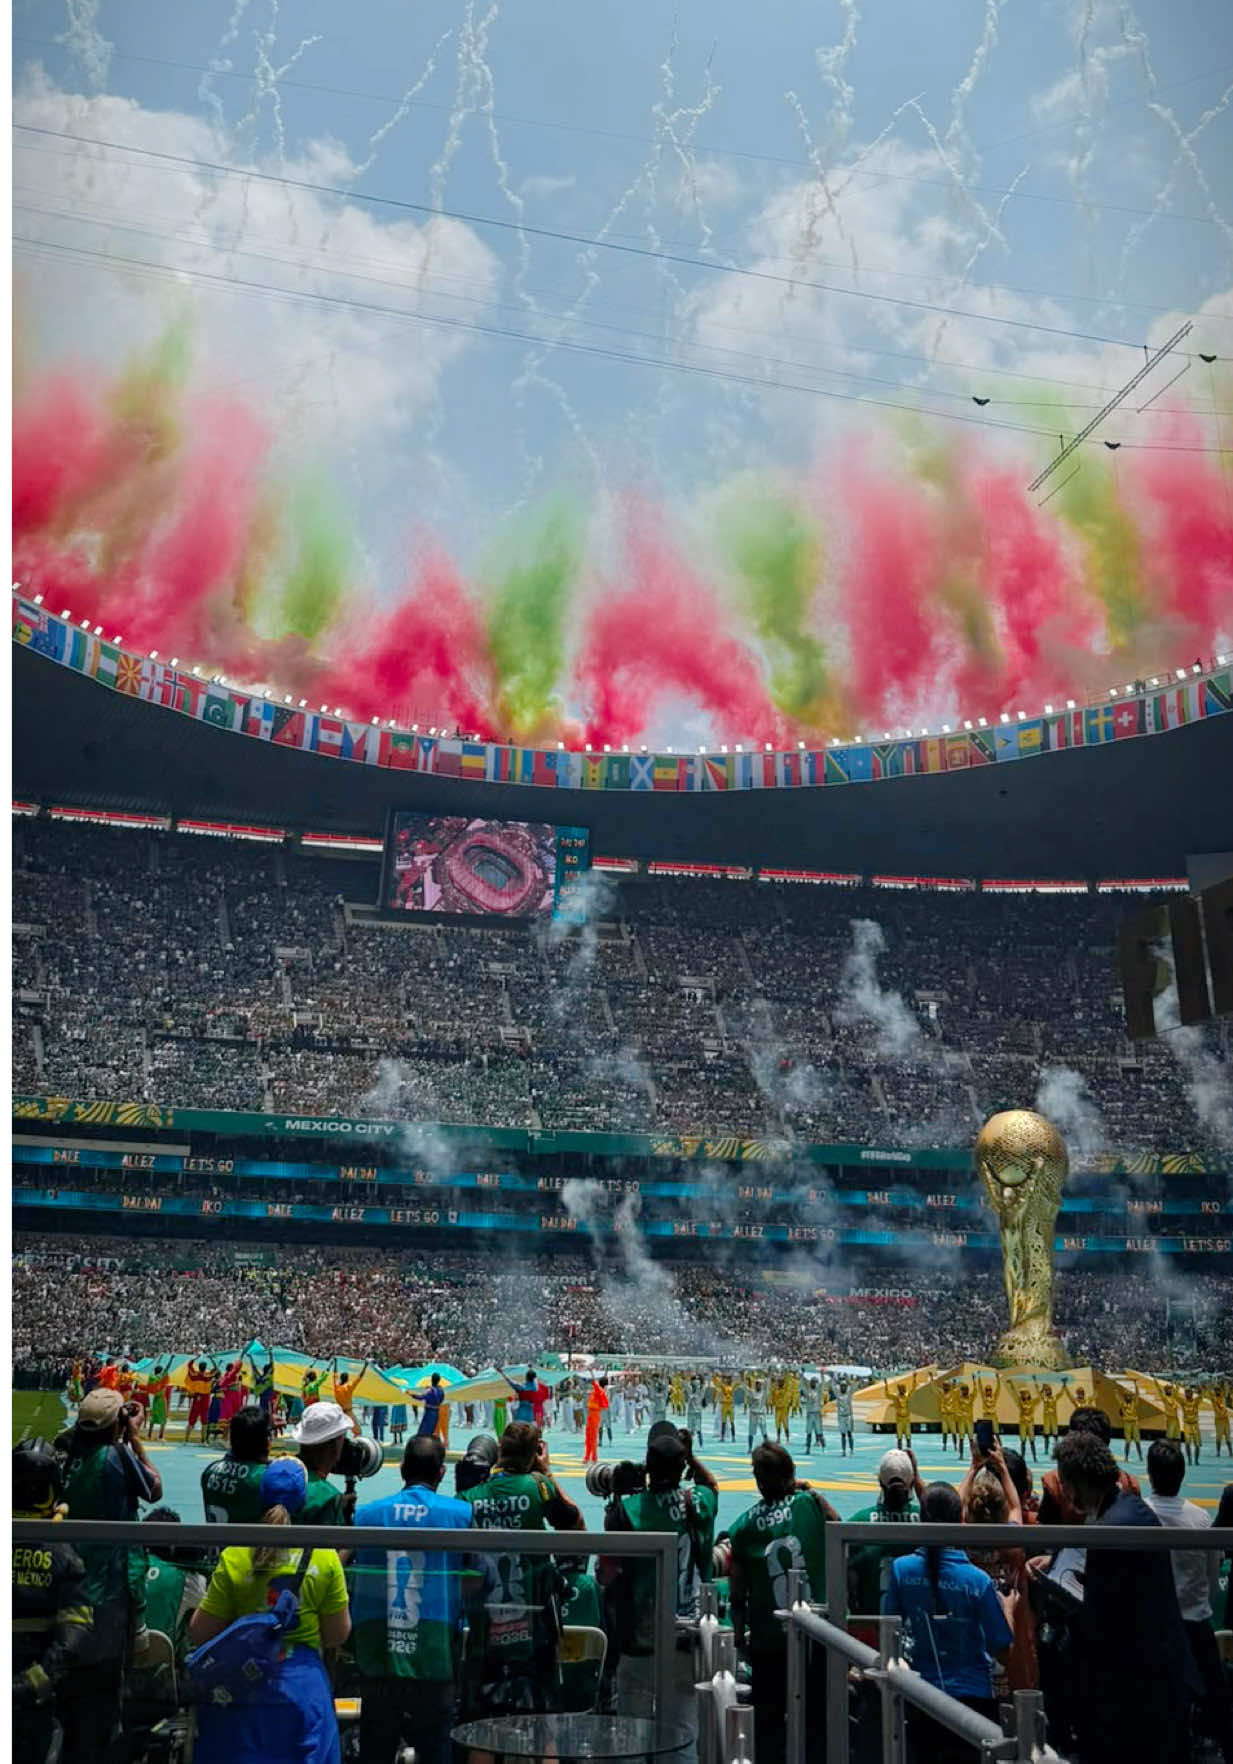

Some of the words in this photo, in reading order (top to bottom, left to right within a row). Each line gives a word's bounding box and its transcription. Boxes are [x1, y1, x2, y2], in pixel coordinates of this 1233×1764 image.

[285, 1119, 352, 1133] MEXICO
[355, 1122, 395, 1135] CITY
[53, 1149, 81, 1163] DALE
[122, 1154, 156, 1168] ALLEZ
[183, 1157, 214, 1172] LET'S
[217, 1160, 234, 1173] GO
[926, 1194, 956, 1208] ALLEZ
[267, 1204, 293, 1218] DALE
[332, 1207, 365, 1222] ALLEZ
[390, 1208, 420, 1224] LET'S
[423, 1210, 440, 1223] GO
[733, 1225, 765, 1239] ALLEZ
[788, 1227, 817, 1241] LET'S
[1184, 1239, 1215, 1252] LET'S
[1217, 1240, 1231, 1251] GO
[850, 1287, 914, 1298] MEXICO
[473, 1494, 531, 1516] PHOTO
[393, 1503, 429, 1522] TPP
[869, 1511, 921, 1525] PHOTO
[12, 1548, 53, 1569] EROS
